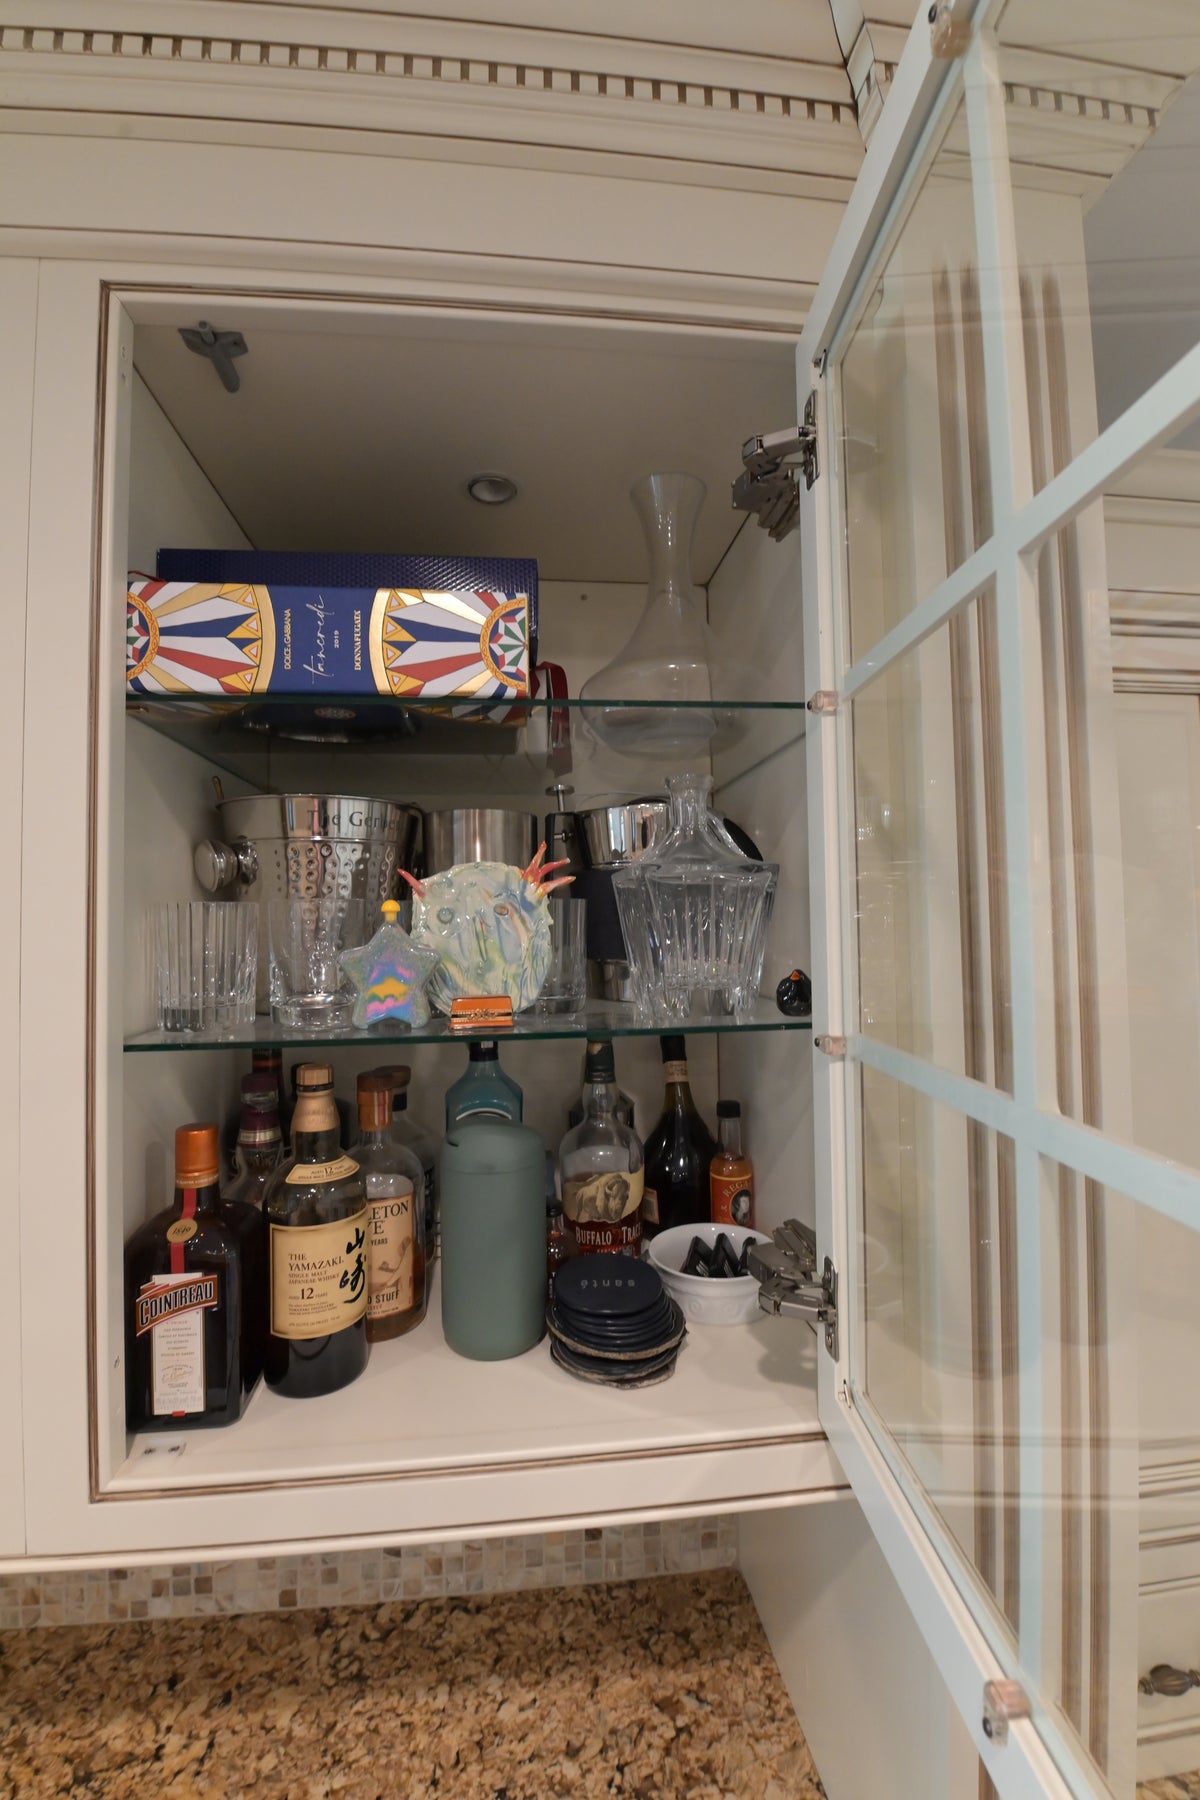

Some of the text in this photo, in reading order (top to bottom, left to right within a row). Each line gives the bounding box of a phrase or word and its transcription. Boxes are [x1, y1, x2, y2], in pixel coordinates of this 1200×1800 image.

[368, 1200, 409, 1221] ETON
[371, 1237, 388, 1247] YEARS
[575, 1226, 612, 1246] BUFFALO
[288, 1253, 307, 1261] THE
[288, 1255, 343, 1272] YAMAZAKI
[311, 1270, 327, 1278] MALT
[317, 1273, 340, 1283] WHISKY
[301, 1287, 314, 1300] 12
[375, 1289, 400, 1304] STUFF
[139, 1281, 214, 1327] COINTREAU
